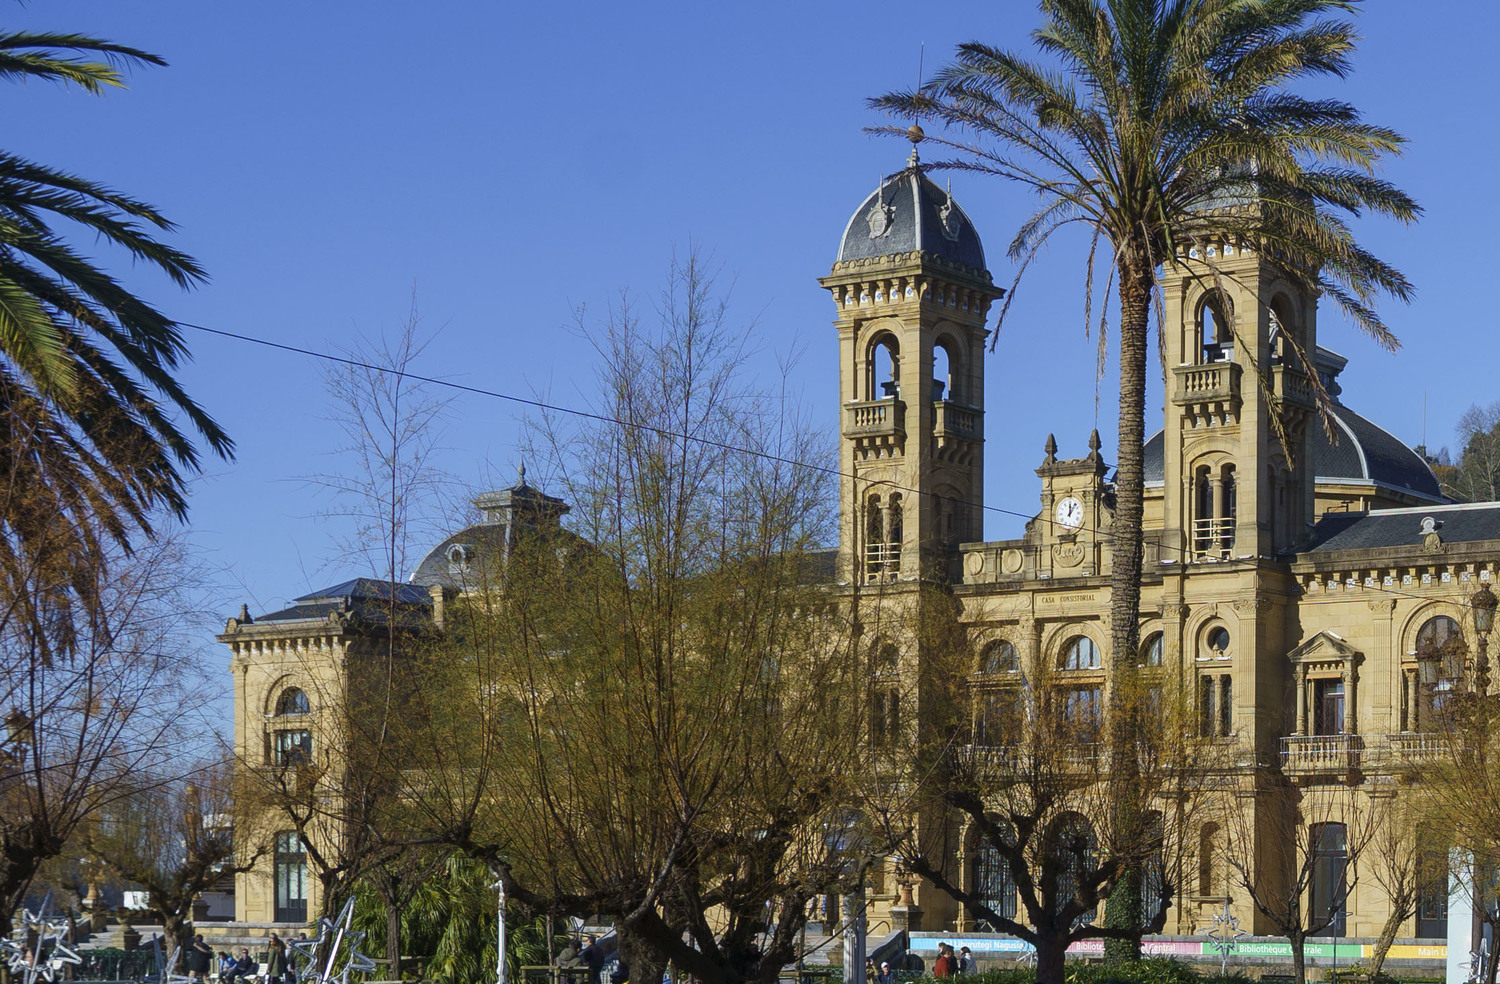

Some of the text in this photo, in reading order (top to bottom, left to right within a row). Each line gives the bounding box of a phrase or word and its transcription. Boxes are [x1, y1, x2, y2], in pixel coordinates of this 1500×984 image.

[1042, 596, 1055, 604] CASA
[1239, 944, 1322, 956] Bibliothèque Ctrale
[1418, 947, 1440, 956] Main
